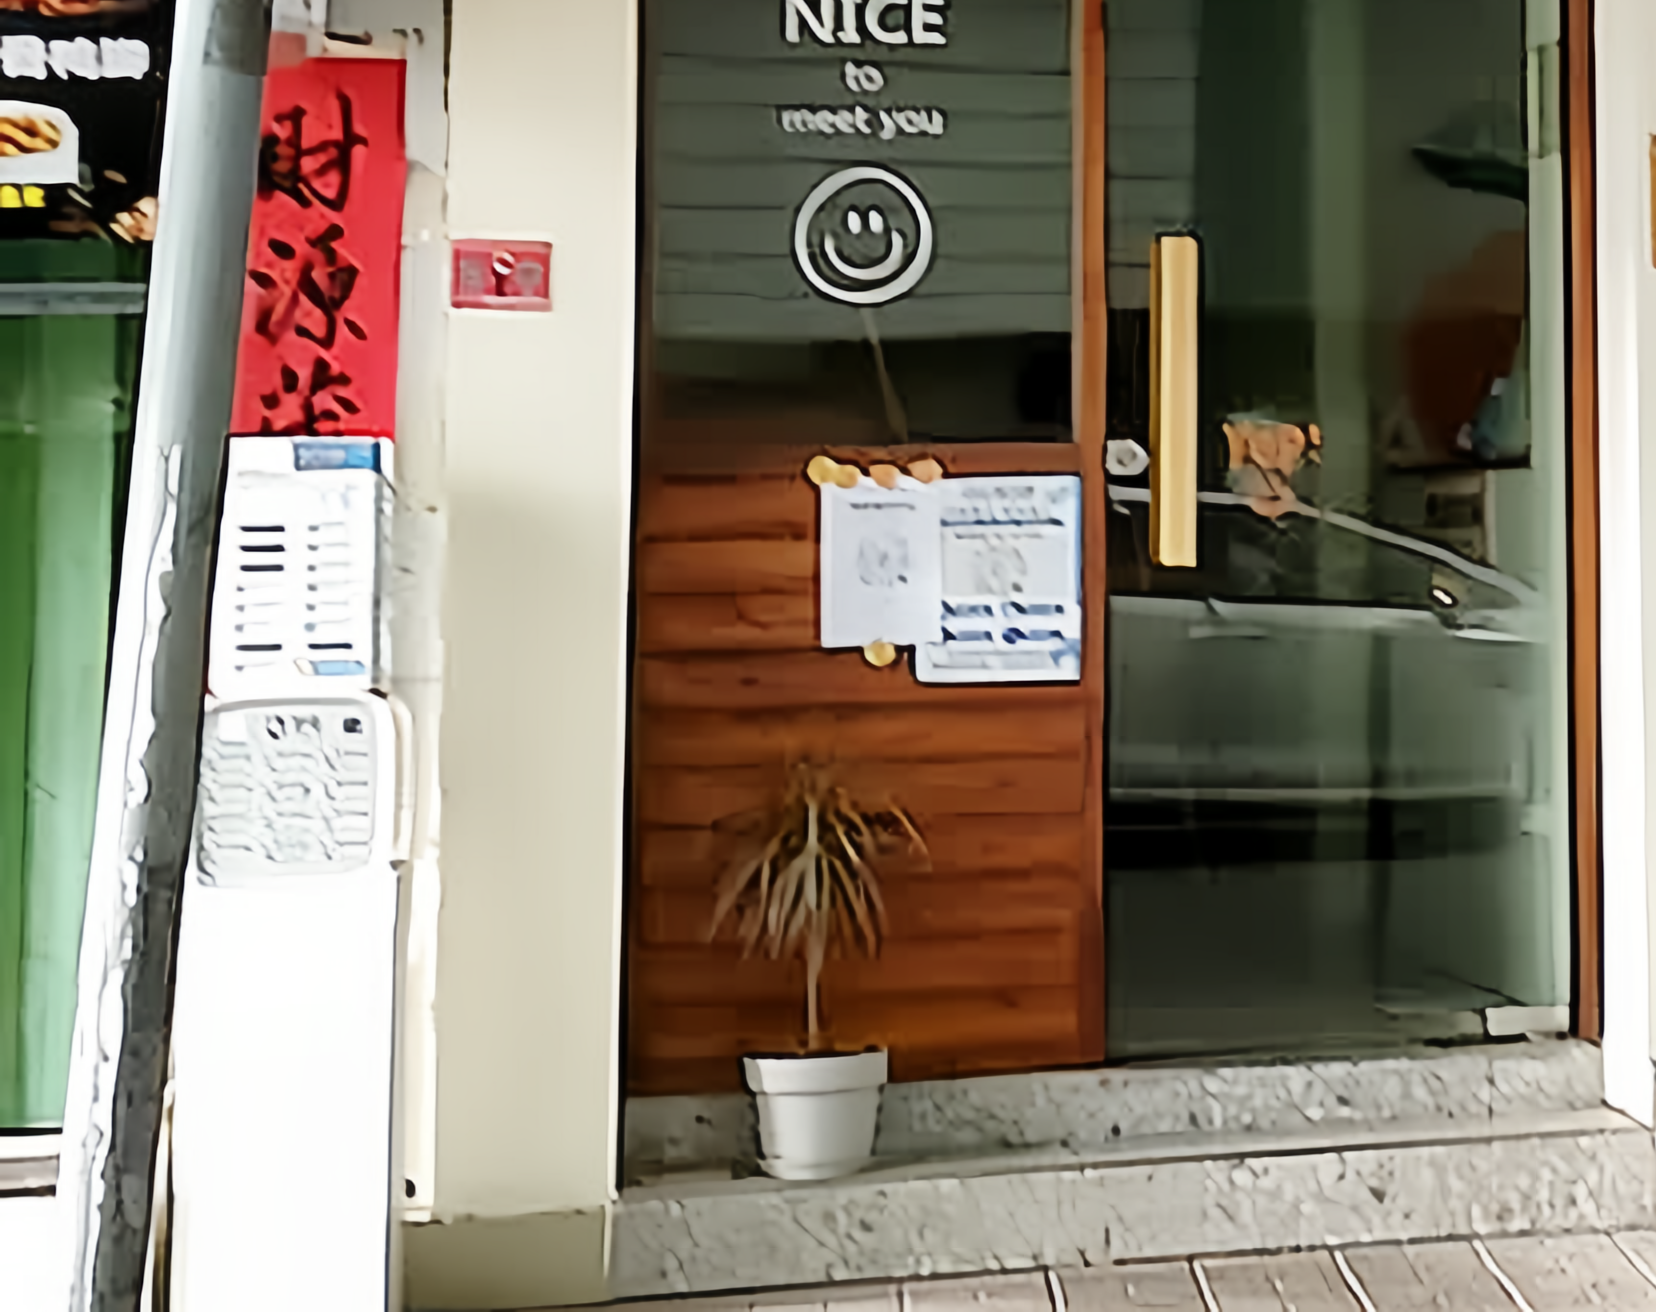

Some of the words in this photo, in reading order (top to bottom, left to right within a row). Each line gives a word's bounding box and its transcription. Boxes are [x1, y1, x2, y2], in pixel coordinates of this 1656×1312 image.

[843, 59, 885, 93] to
[780, 105, 872, 134] meet
[878, 107, 946, 141] you
